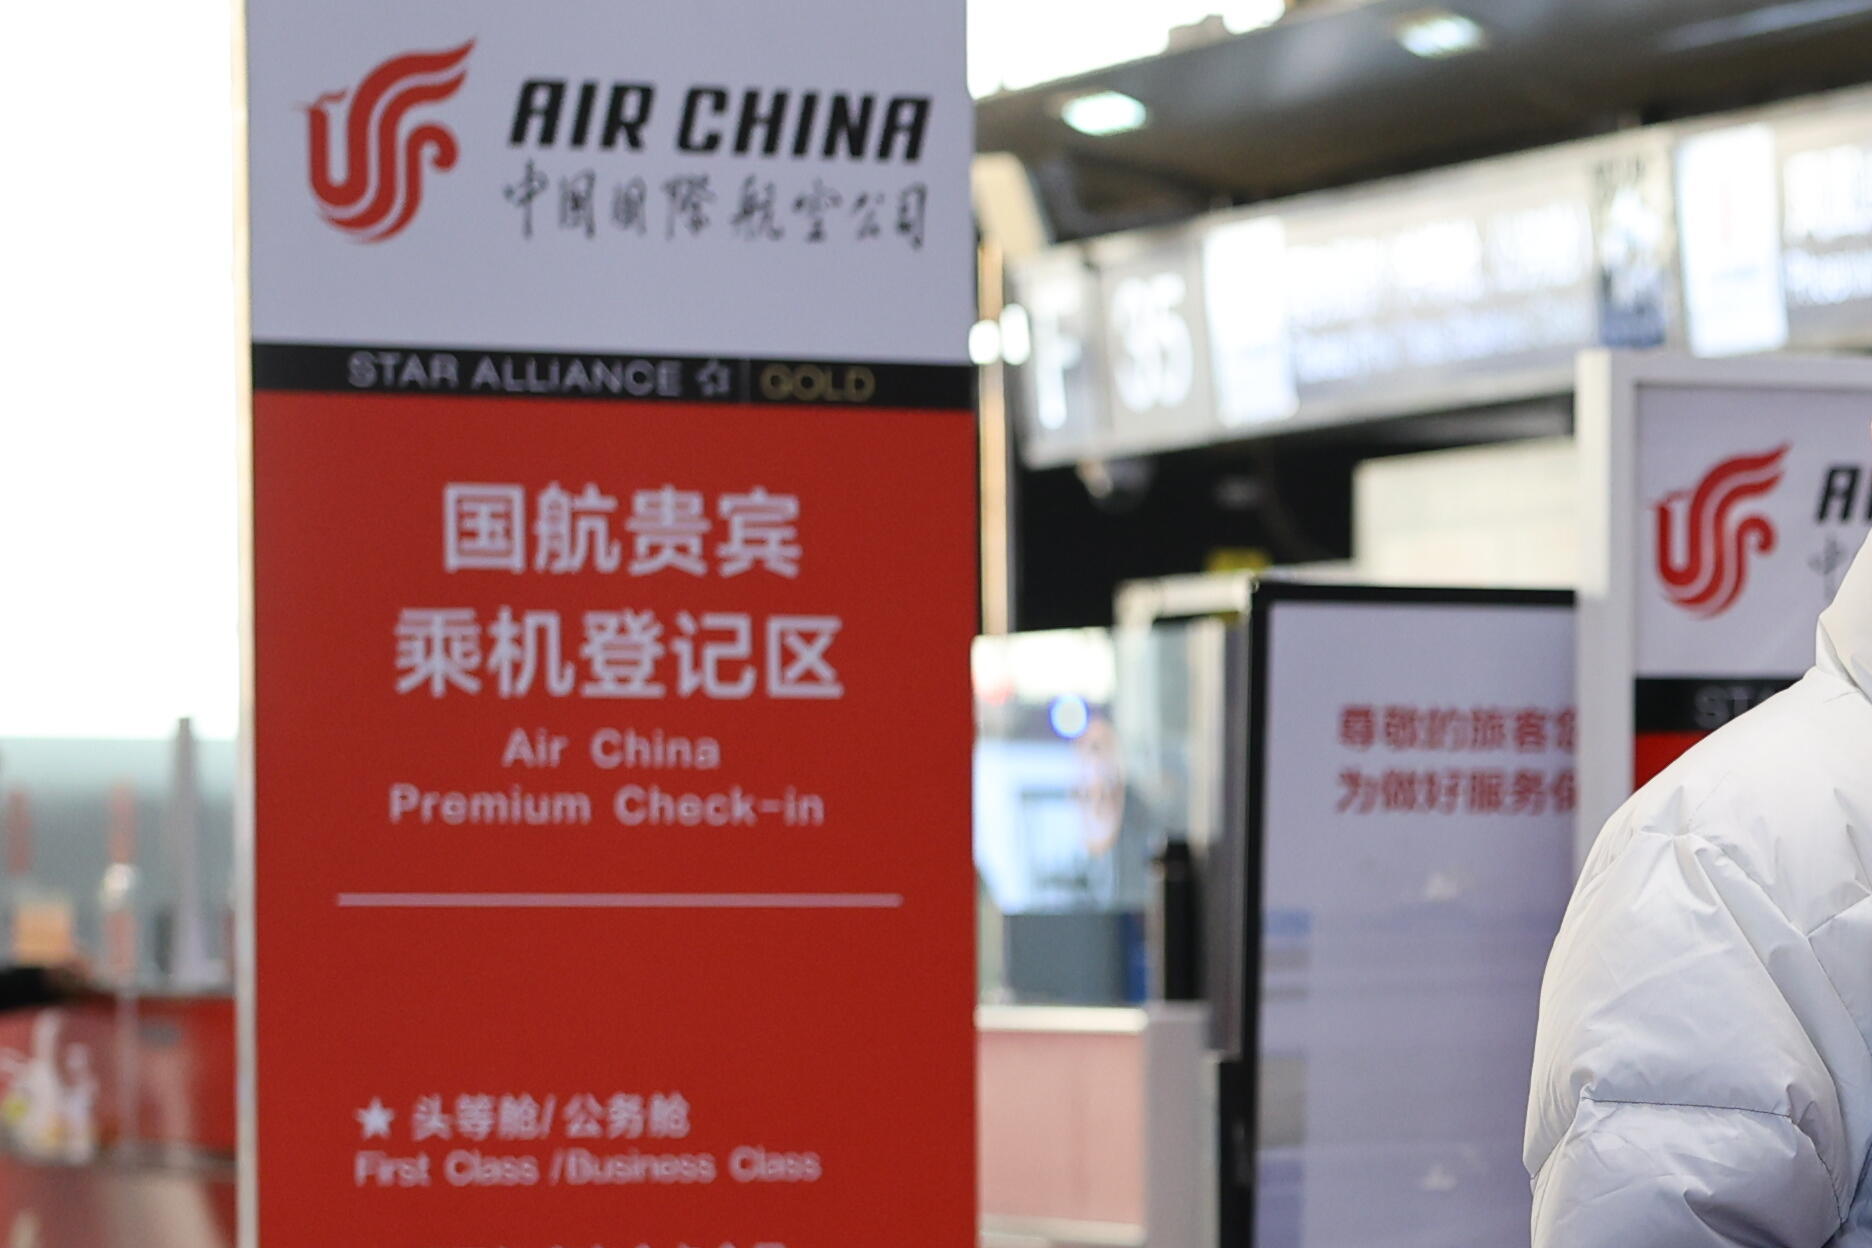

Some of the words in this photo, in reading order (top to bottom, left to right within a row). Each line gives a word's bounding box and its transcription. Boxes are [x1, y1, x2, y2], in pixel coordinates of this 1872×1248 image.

[510, 79, 654, 150] AIR
[676, 87, 931, 162] CHINA
[347, 350, 459, 389] STAR
[470, 355, 684, 398] ALLIANCE
[760, 363, 876, 402] GOLD
[442, 480, 803, 579] 国航贵宾
[393, 604, 845, 700] 乘机登记区
[502, 728, 568, 769] Air
[589, 728, 720, 769] China
[389, 783, 591, 825] Premium
[614, 784, 825, 827] Check-in
[354, 1150, 430, 1187] First
[444, 1149, 540, 1186] Class
[728, 1144, 823, 1183] Class
